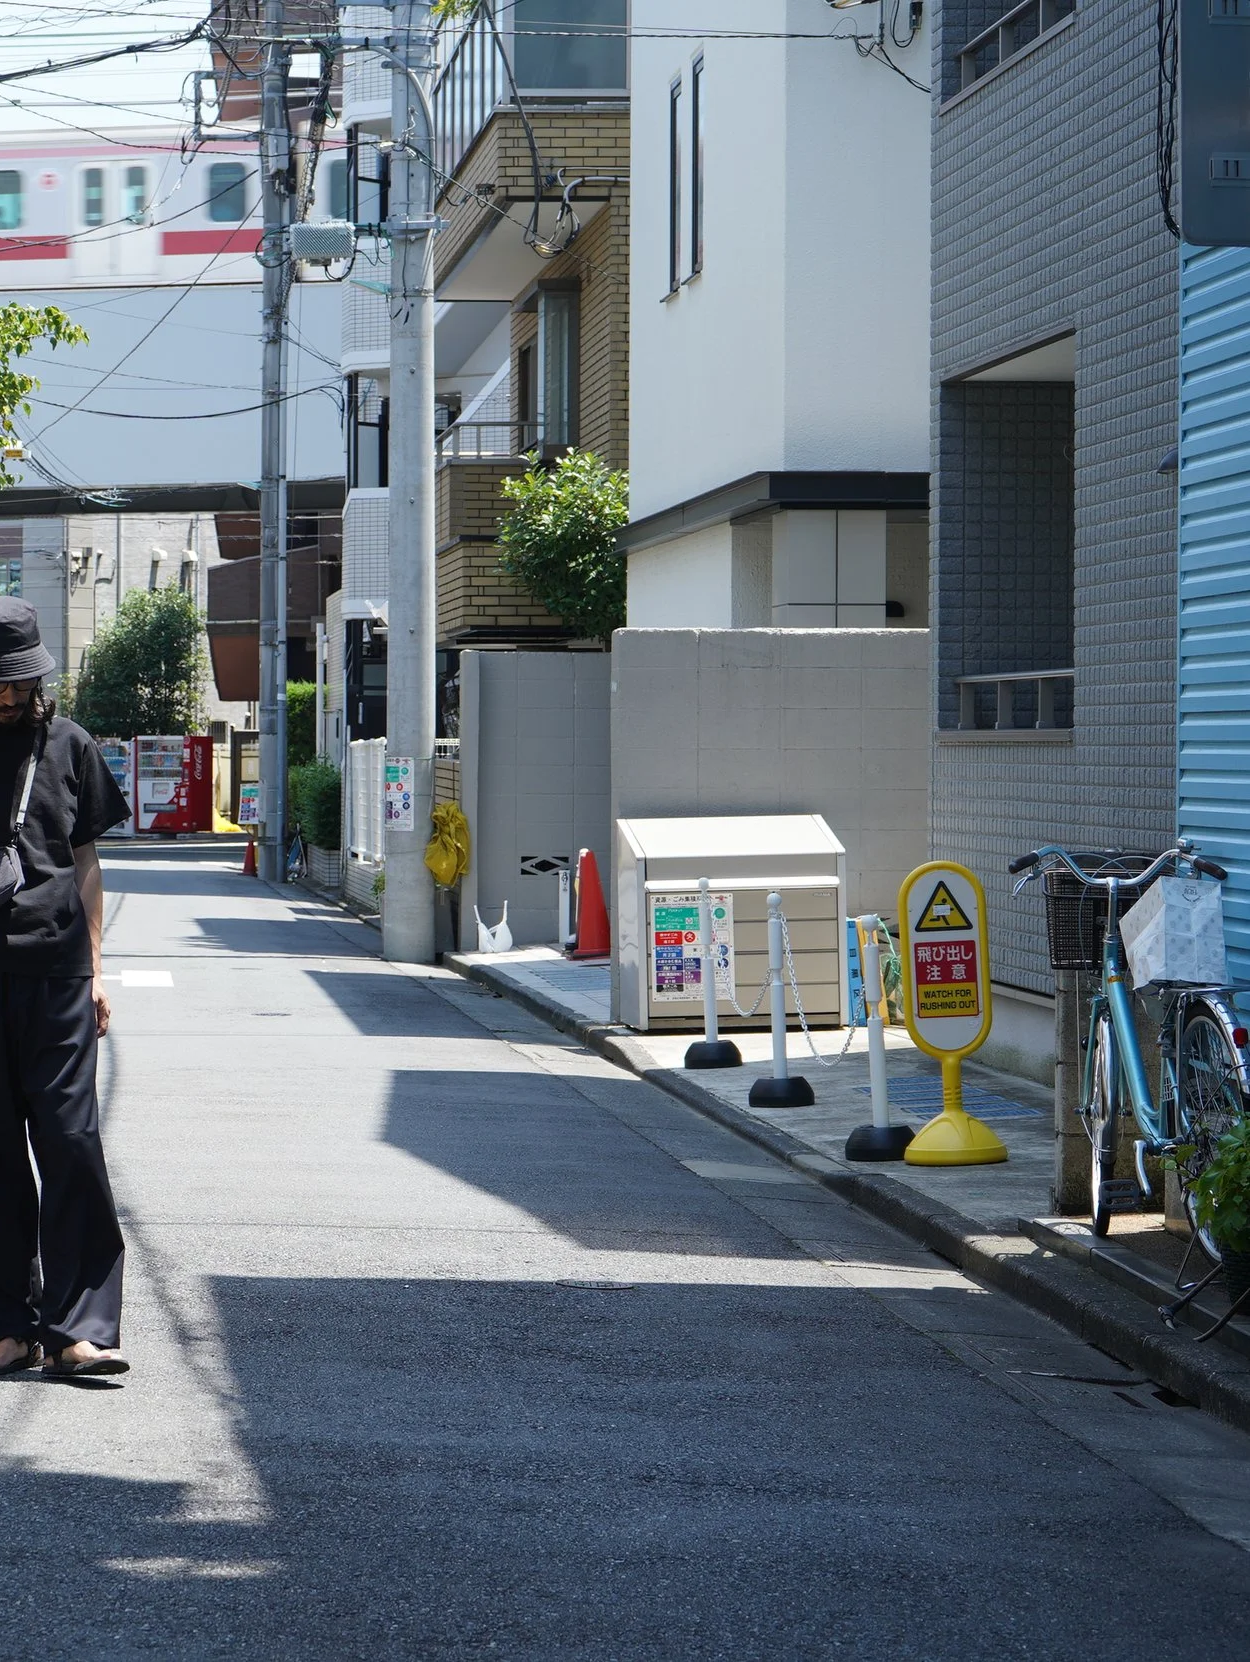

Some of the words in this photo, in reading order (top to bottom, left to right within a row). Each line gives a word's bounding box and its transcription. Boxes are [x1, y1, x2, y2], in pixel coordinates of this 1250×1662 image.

[917, 945, 973, 963] 飛び出し
[926, 964, 967, 981] 注意
[924, 990, 953, 999] WATCH
[955, 989, 971, 997] FOR
[920, 1001, 957, 1010] RUSHING
[959, 1000, 976, 1009] OUT
